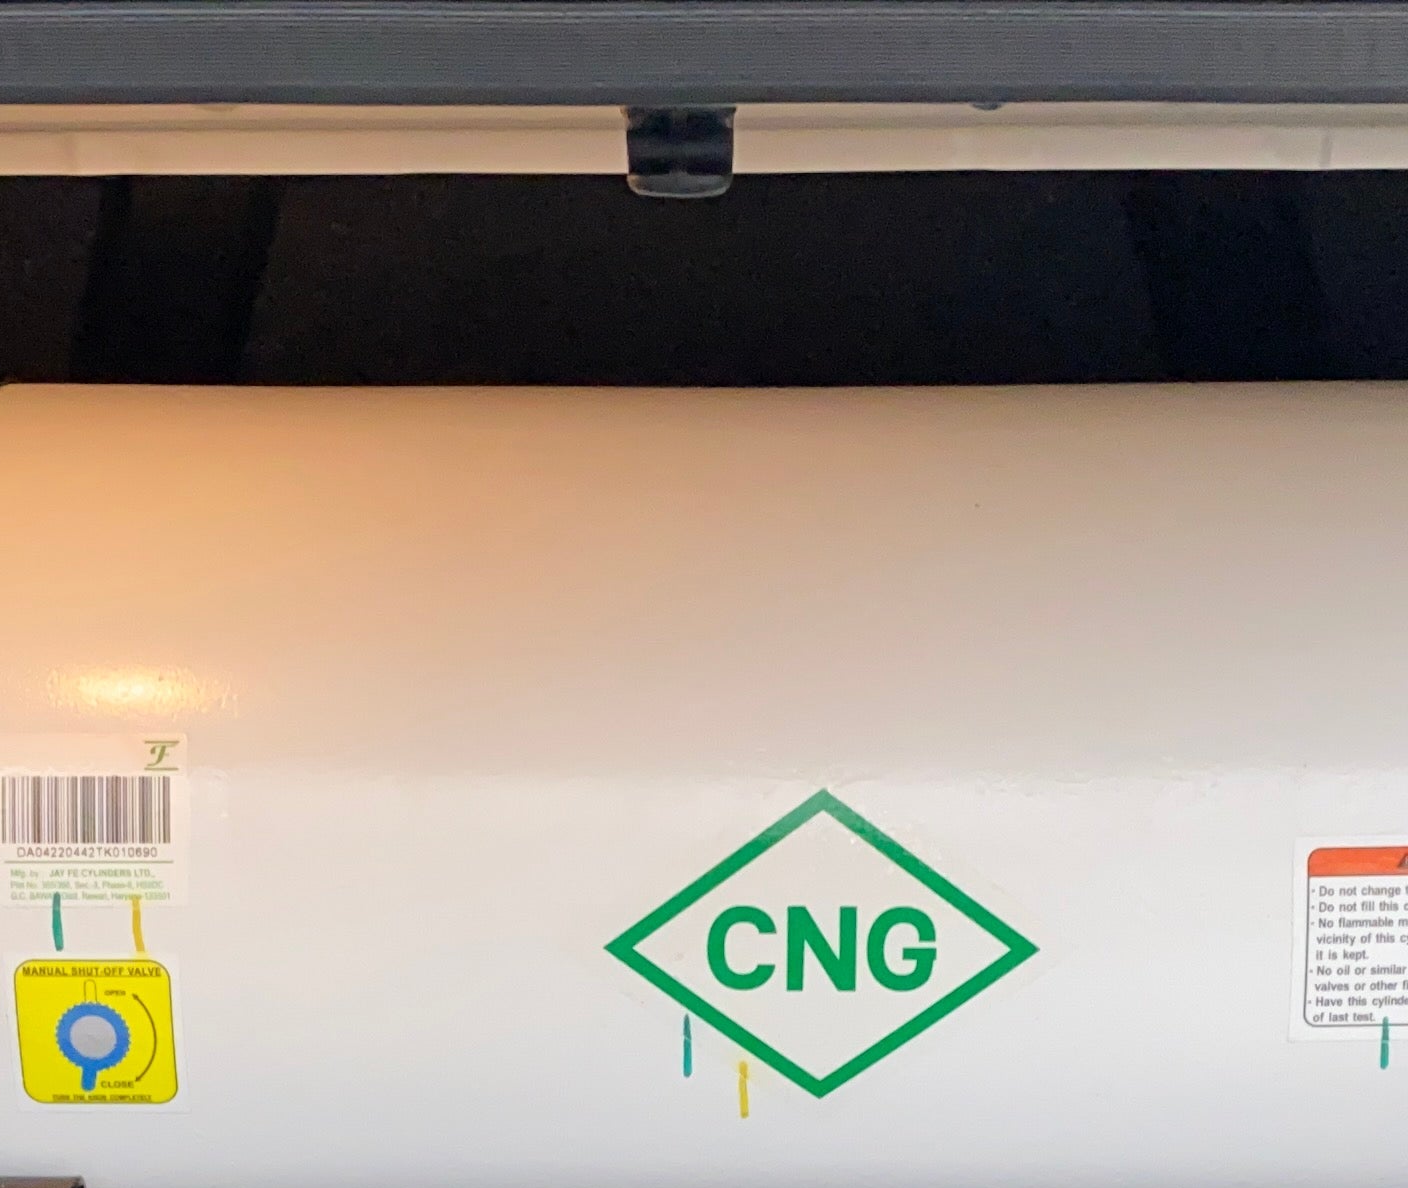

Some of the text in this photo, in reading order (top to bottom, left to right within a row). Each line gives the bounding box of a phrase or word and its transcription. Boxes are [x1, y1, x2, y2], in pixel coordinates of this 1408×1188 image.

[49, 869, 65, 877] JAY
[81, 869, 132, 877] CYLINDERS
[1319, 885, 1334, 896] Do
[1340, 887, 1357, 896] not
[1361, 885, 1401, 897] change
[1319, 902, 1334, 912] Do
[1339, 902, 1357, 911] not
[1361, 902, 1375, 911] fill
[1379, 902, 1399, 911] this
[1318, 918, 1333, 928] No
[1339, 917, 1394, 927] flammable
[1317, 935, 1356, 946] vicinity
[1360, 933, 1372, 943] of
[1376, 933, 1395, 943] this
[707, 906, 937, 992] CNG
[1316, 949, 1368, 961] it is kept.
[22, 967, 68, 976] MANUAL
[127, 967, 161, 976] VALVE
[1317, 966, 1332, 976] No
[1337, 966, 1350, 975] oil
[1355, 967, 1366, 975] or
[1370, 965, 1406, 974] similar
[1315, 981, 1349, 991] valves
[1354, 982, 1365, 990] or
[1370, 980, 1397, 990] other
[1316, 997, 1342, 1006] Have
[1348, 996, 1367, 1006] this
[1313, 1012, 1375, 1022] of last test.
[100, 1081, 134, 1089] CLOSE
